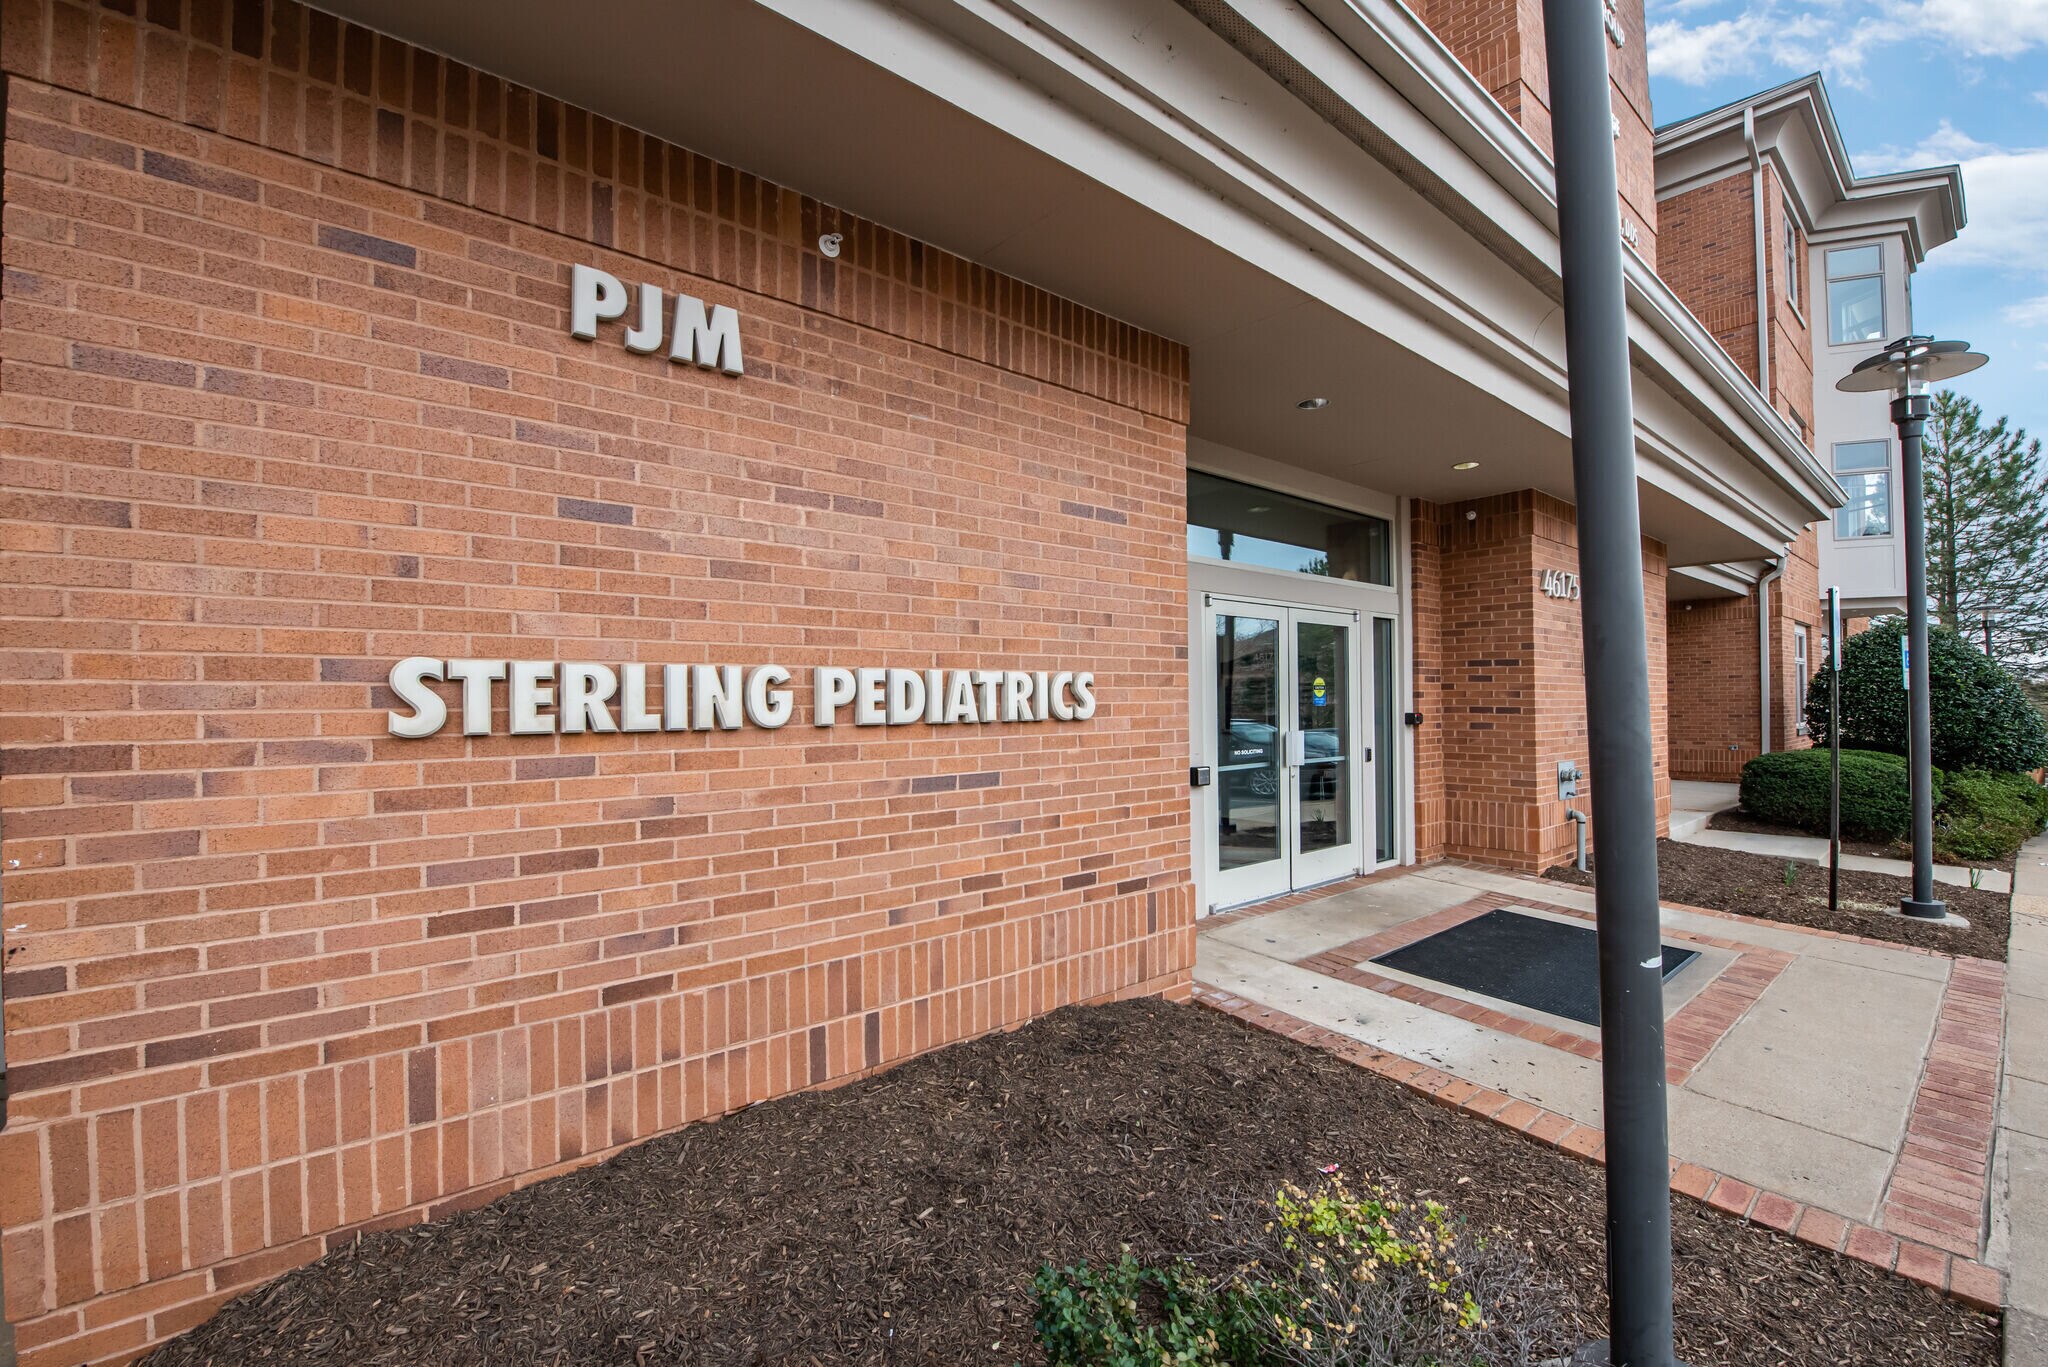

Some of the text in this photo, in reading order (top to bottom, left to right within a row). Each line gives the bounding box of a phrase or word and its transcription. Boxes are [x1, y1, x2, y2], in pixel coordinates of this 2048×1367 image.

[571, 262, 744, 377] PJM
[1542, 568, 1580, 600] 46175
[387, 656, 1097, 739] STERLING PEDIATRICS
